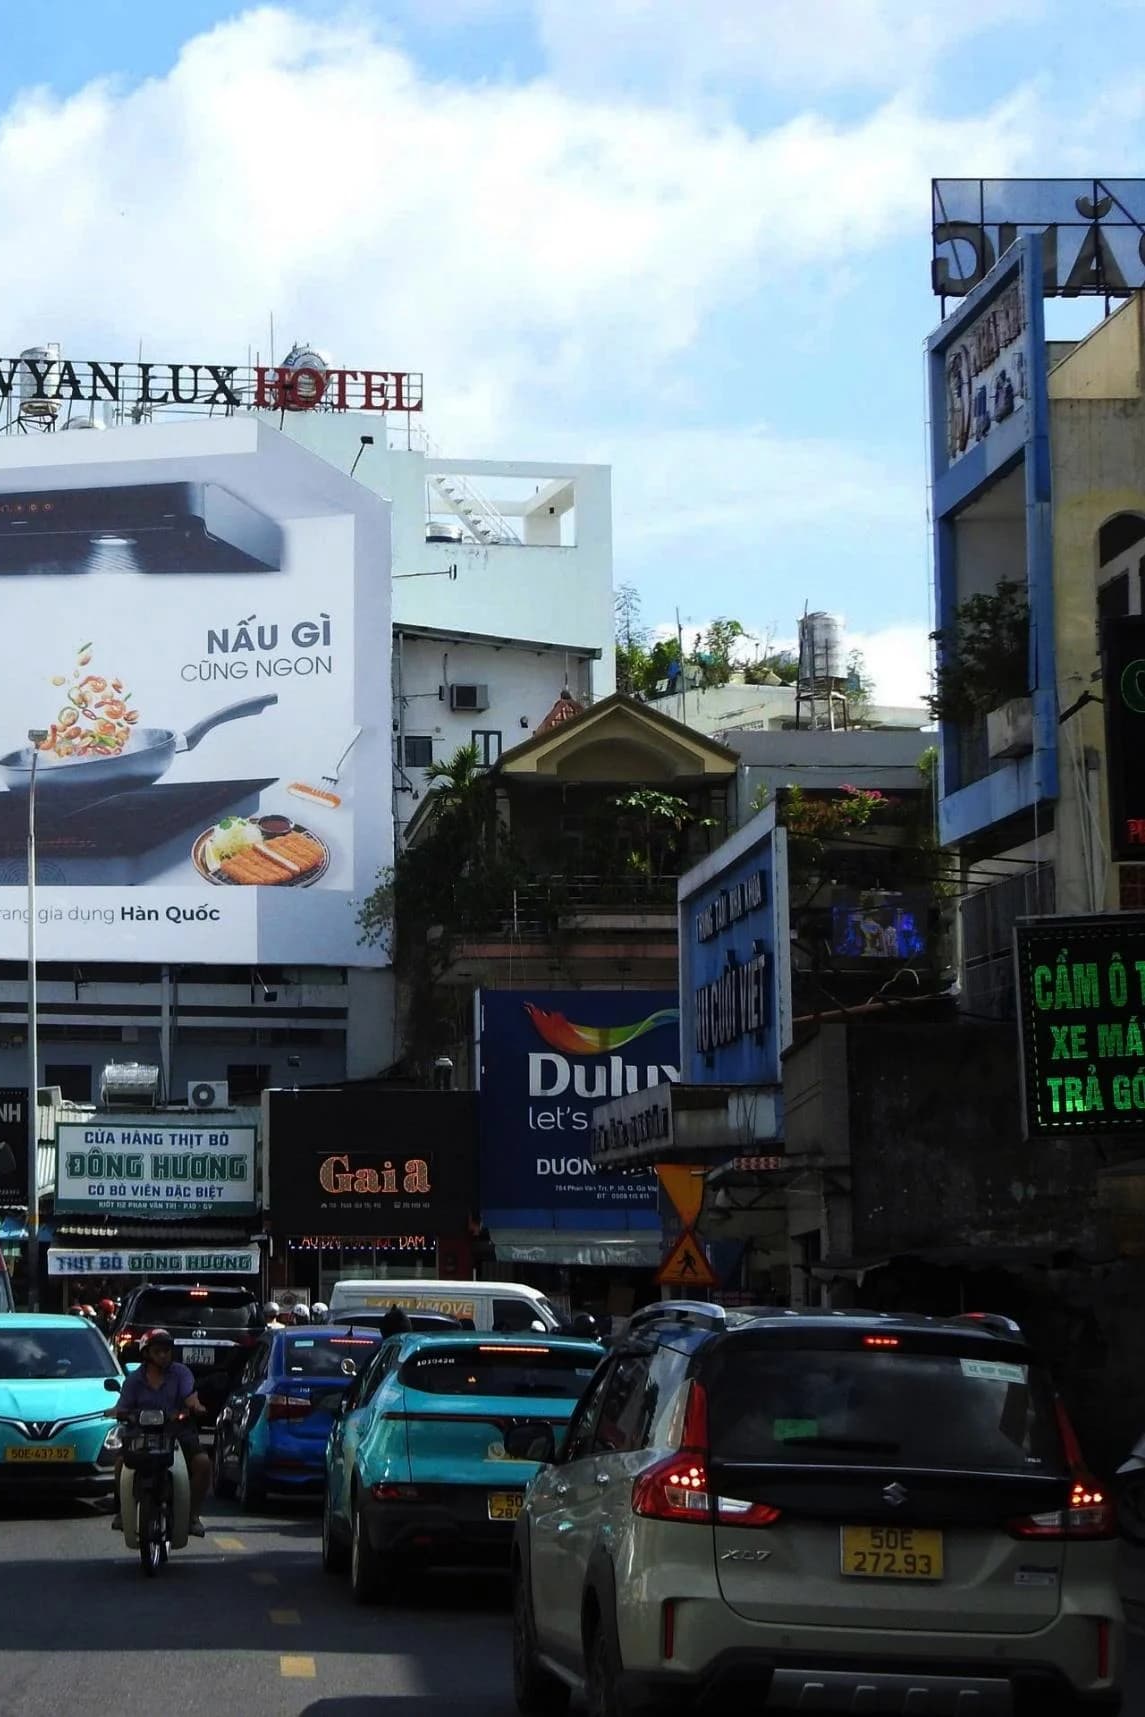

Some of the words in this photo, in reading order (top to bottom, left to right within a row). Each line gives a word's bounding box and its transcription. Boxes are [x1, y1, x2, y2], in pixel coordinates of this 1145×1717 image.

[137, 364, 239, 405] LUX
[254, 366, 422, 411] HOTEL
[207, 614, 278, 654] NẤU
[291, 613, 330, 648] GÌ
[181, 660, 248, 682] CŨNG
[256, 656, 331, 678] NGON
[38, 907, 63, 924] gia
[68, 905, 115, 925] dụng
[121, 905, 159, 921] Hàn
[165, 903, 220, 924] Quốc
[1108, 952, 1128, 1008] Ô
[1049, 1024, 1088, 1060] XE
[1097, 1015, 1145, 1058] MÁ
[1046, 1064, 1104, 1113] TRẢ
[85, 1129, 115, 1145] CỬA
[121, 1131, 163, 1145] HÀNG
[170, 1133, 203, 1149] THỊT
[209, 1131, 229, 1146] BÒ
[151, 1152, 247, 1181] HƯƠNG
[319, 1155, 431, 1193] Gaia
[537, 1156, 597, 1176] DƯƠN
[88, 1184, 104, 1196] CÓ
[110, 1184, 126, 1196] BÒ
[131, 1183, 160, 1197] VIÊN
[166, 1185, 191, 1199] ĐẶC
[196, 1184, 224, 1199] BIỆT
[57, 1256, 94, 1271] THỊT
[99, 1254, 122, 1270] BÒ
[185, 1254, 252, 1271] HƯƠNG
[870, 1528, 913, 1549] 50E
[854, 1552, 932, 1576] 272.93
